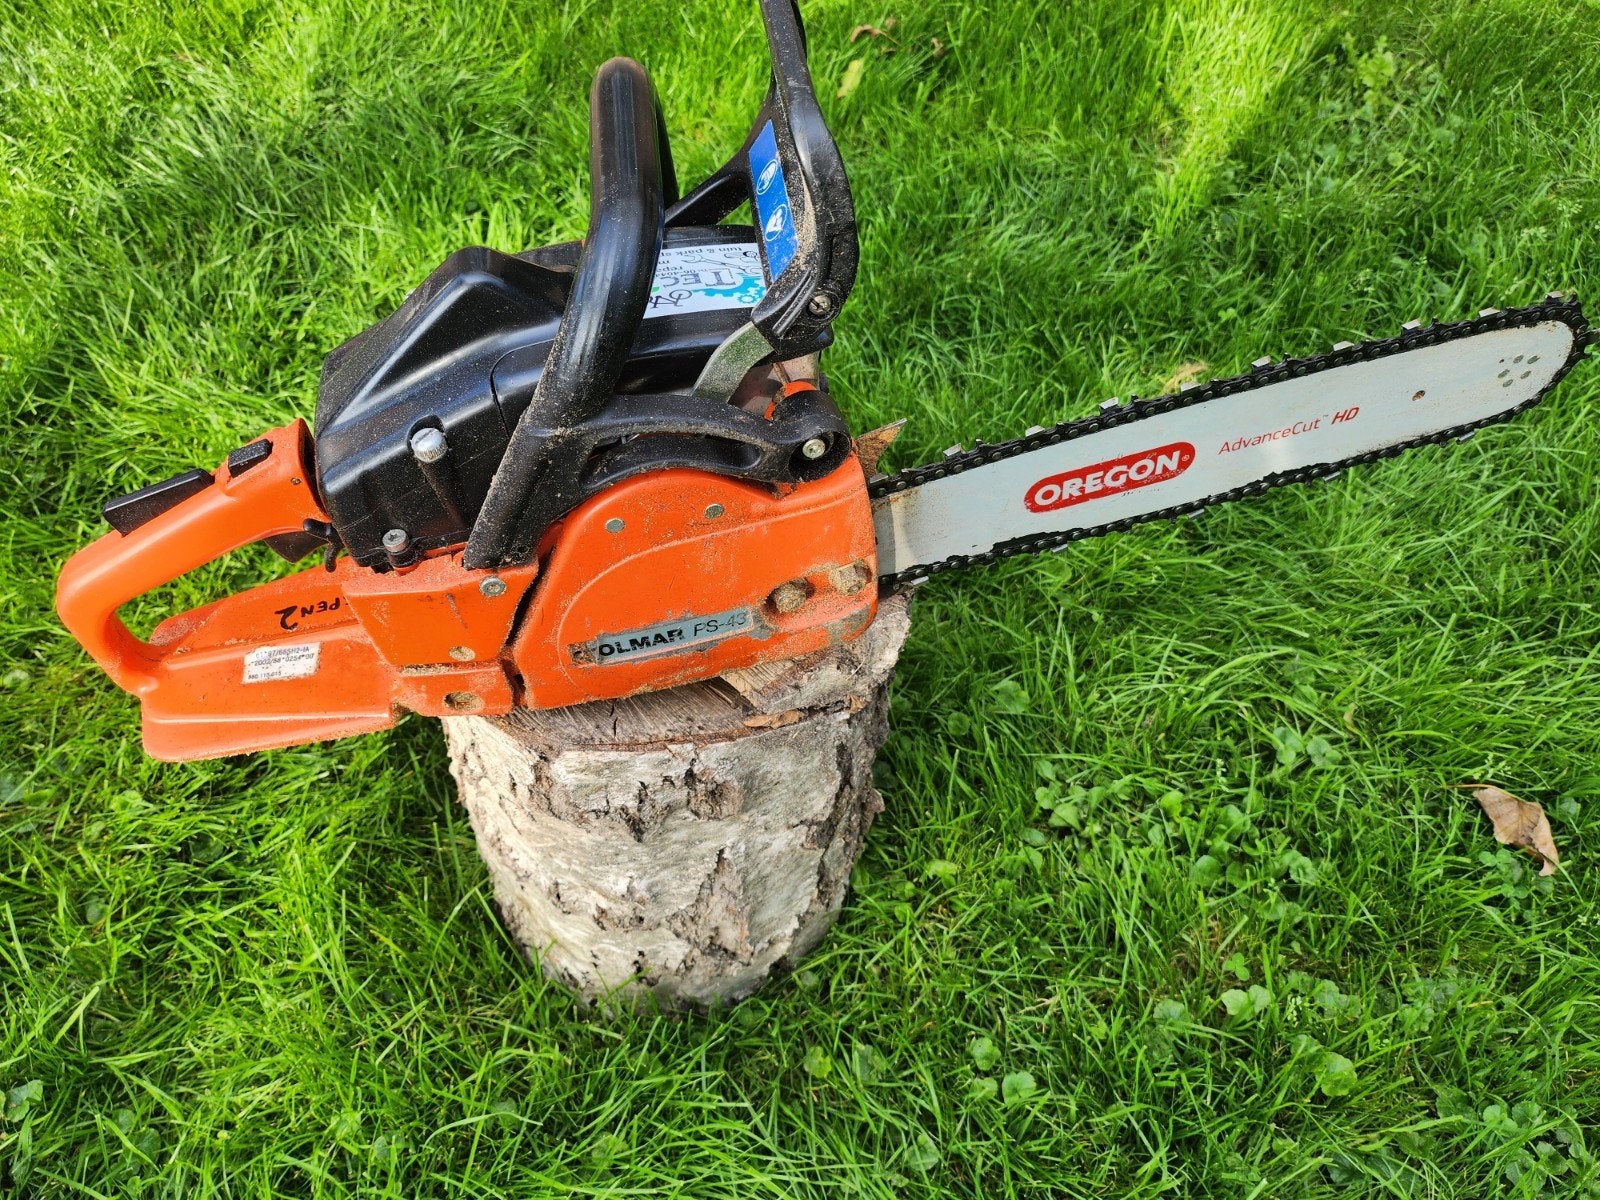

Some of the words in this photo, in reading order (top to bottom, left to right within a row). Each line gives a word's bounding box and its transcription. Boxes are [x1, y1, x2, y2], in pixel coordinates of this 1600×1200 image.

[1331, 406, 1360, 425] HD
[1033, 450, 1183, 507] OREGON
[274, 605, 299, 631] 2
[300, 597, 342, 618] PEN
[598, 627, 684, 657] OLMAR
[693, 611, 748, 638] PS-43
